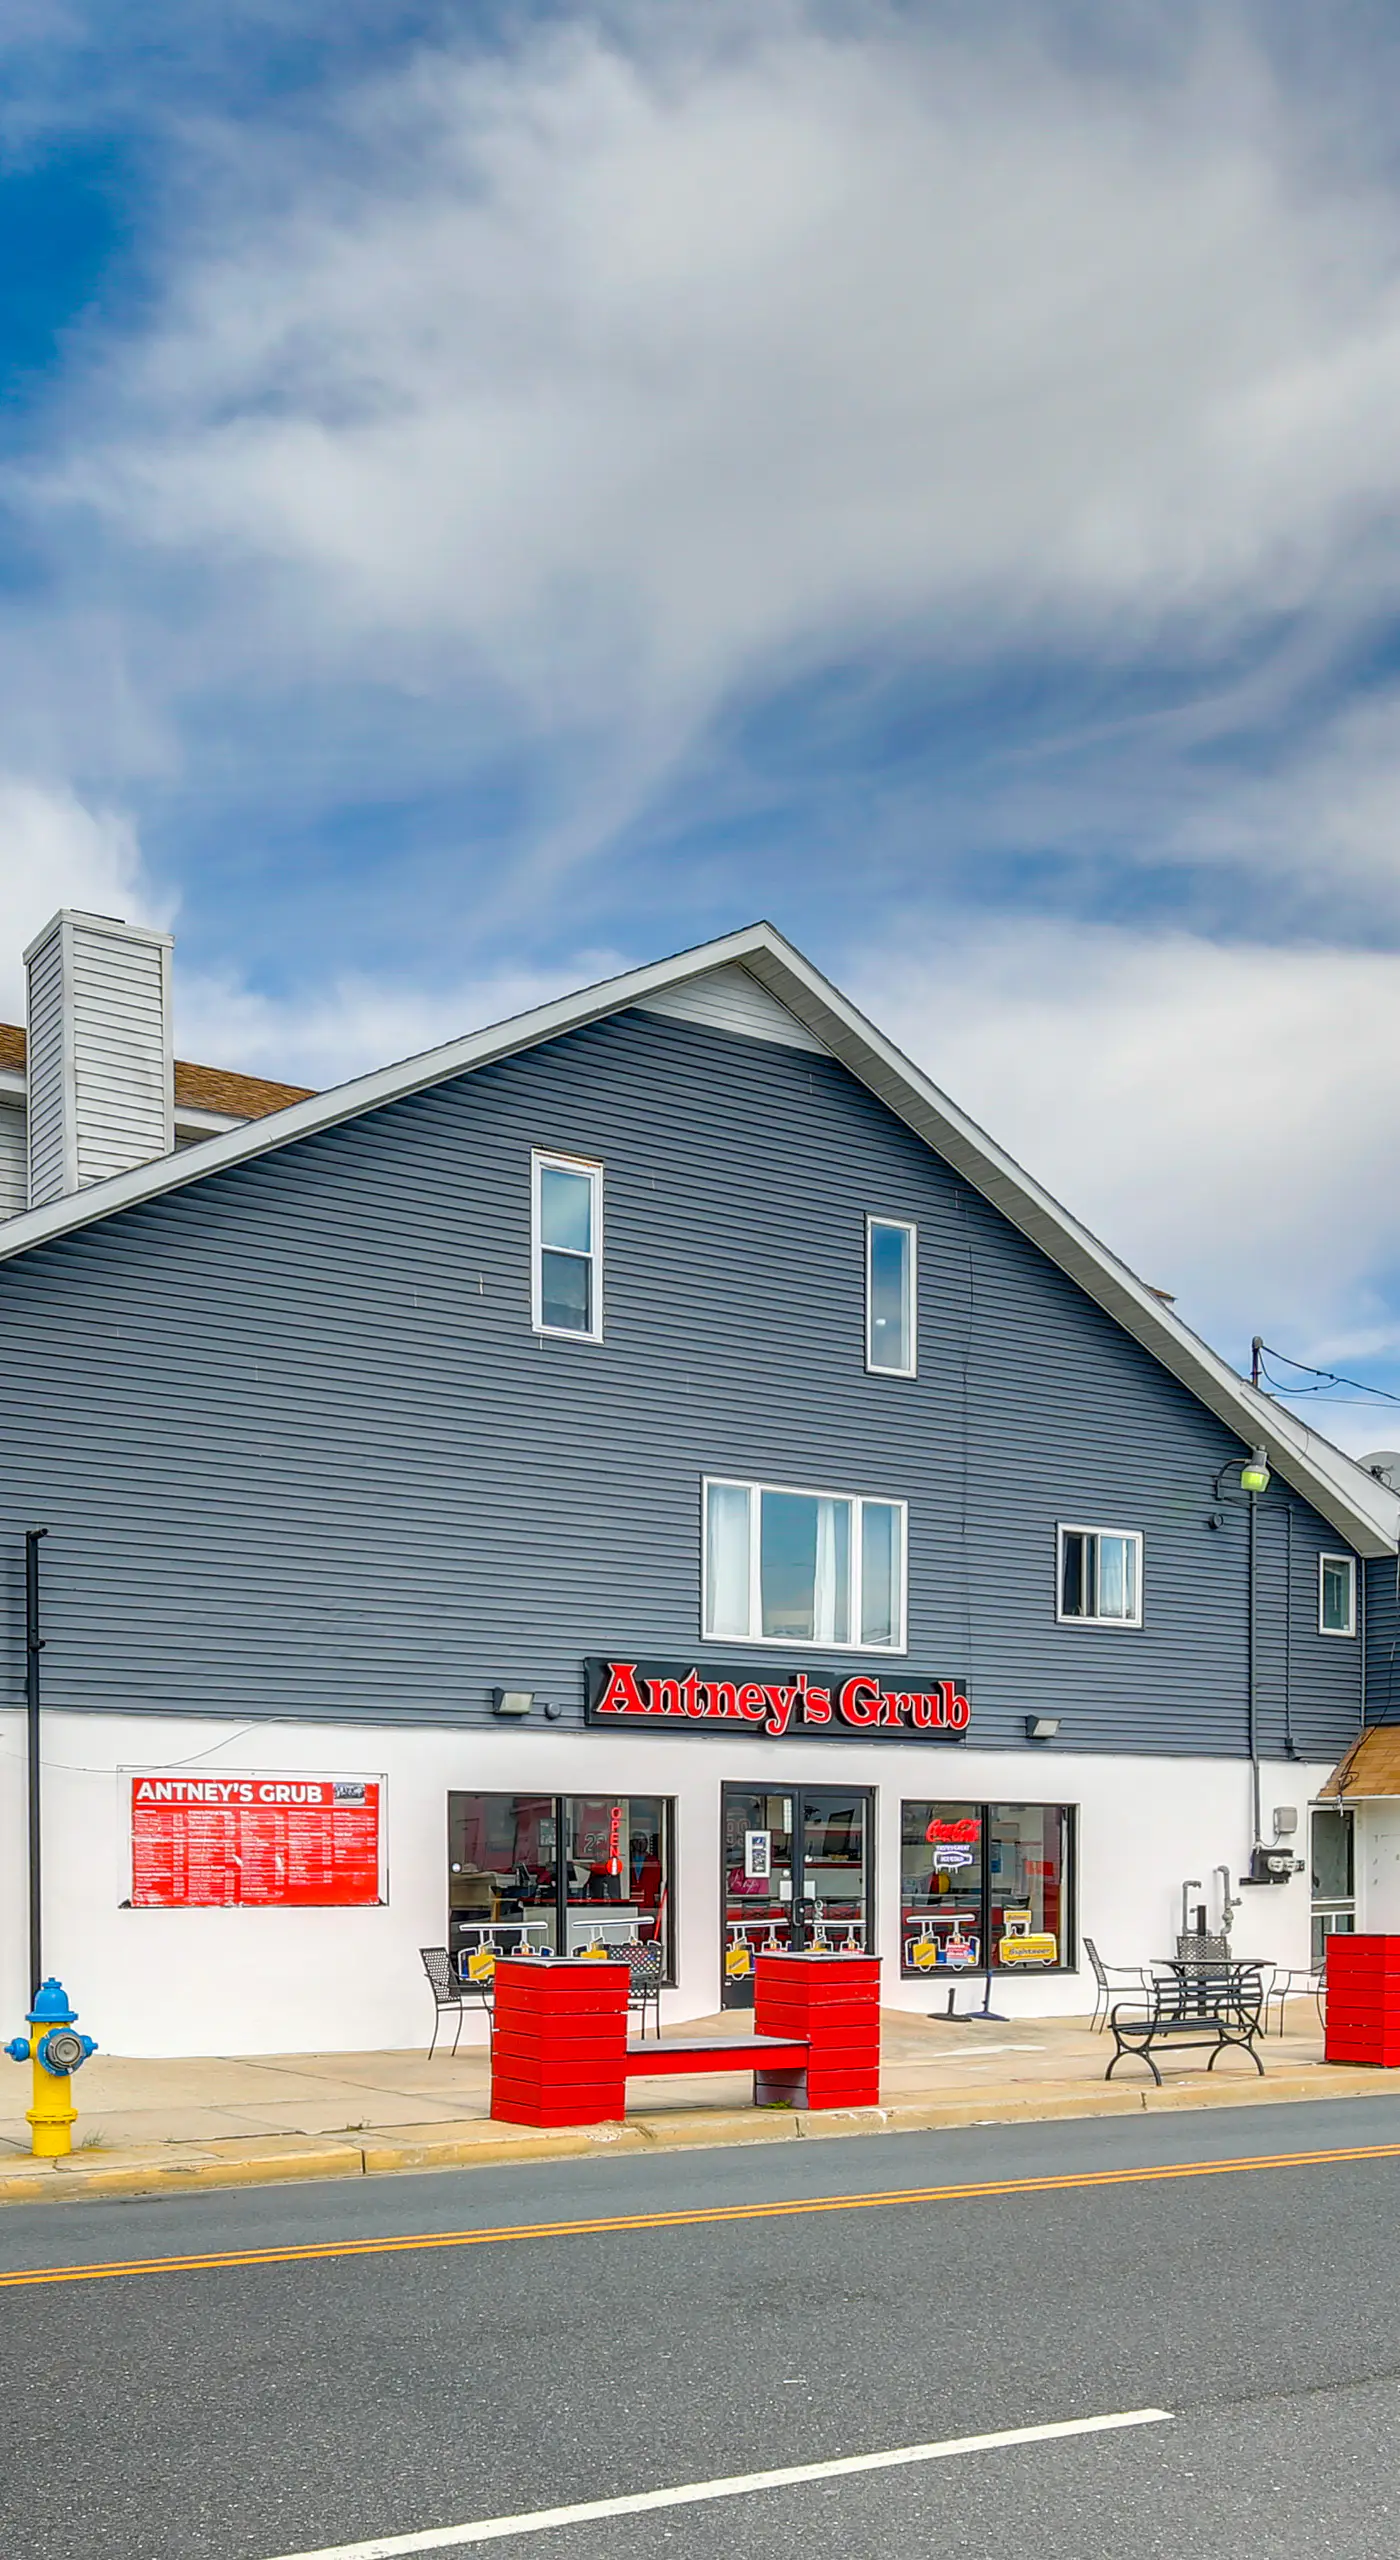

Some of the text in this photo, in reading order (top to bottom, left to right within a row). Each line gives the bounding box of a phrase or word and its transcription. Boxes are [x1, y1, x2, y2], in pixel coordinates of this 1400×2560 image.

[596, 1662, 971, 1736] Antney's Grub
[136, 1782, 253, 1802] ANTNEY'S
[258, 1784, 322, 1803] GRUB
[610, 1807, 622, 1857] OPEN
